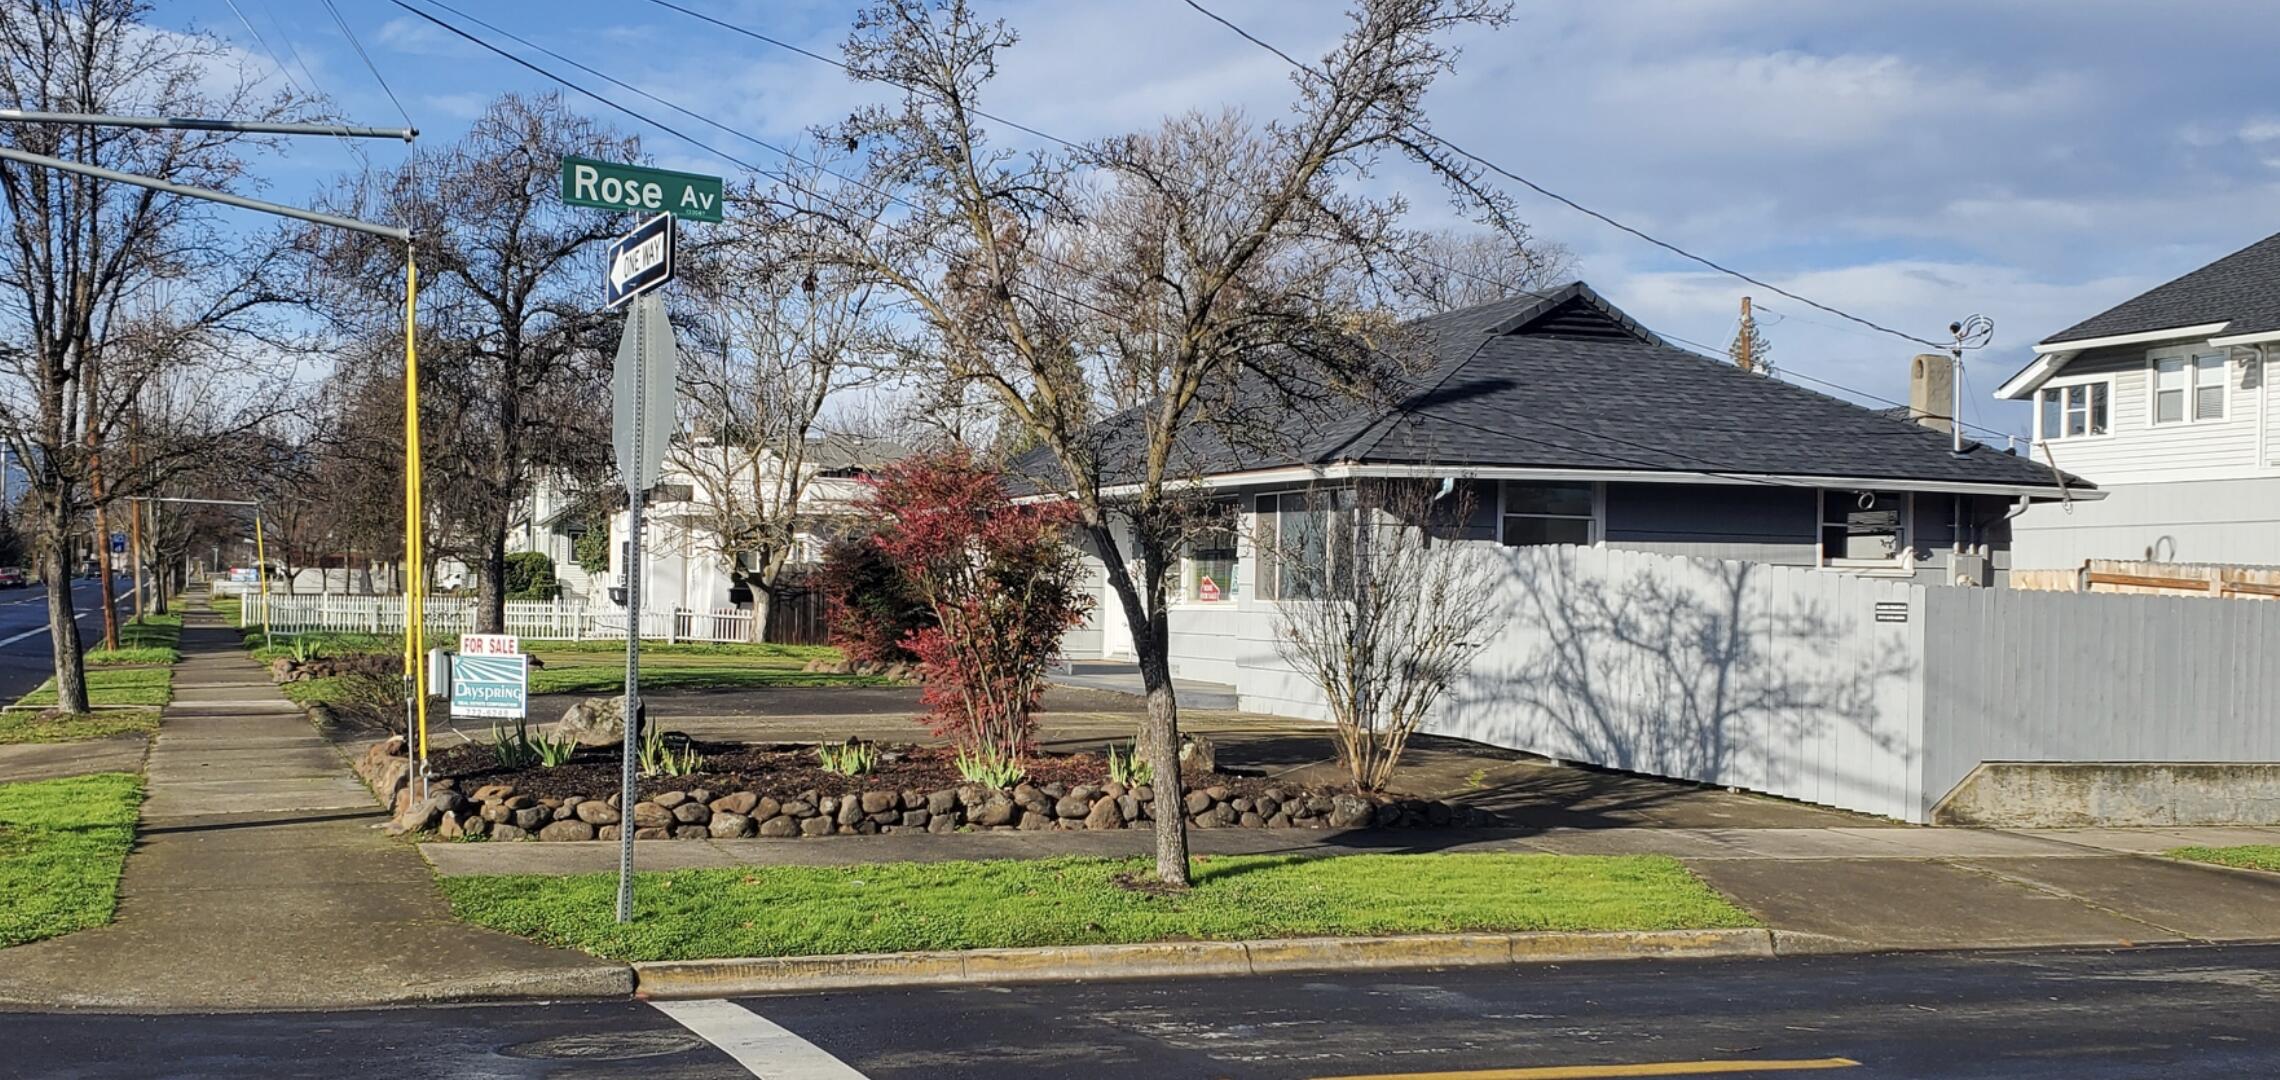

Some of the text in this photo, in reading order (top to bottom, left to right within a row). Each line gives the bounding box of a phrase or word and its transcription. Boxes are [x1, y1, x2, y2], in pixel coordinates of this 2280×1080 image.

[575, 164, 714, 210] Rose Av
[623, 236, 662, 279] ONE WAY
[464, 638, 515, 655] FOR SALE
